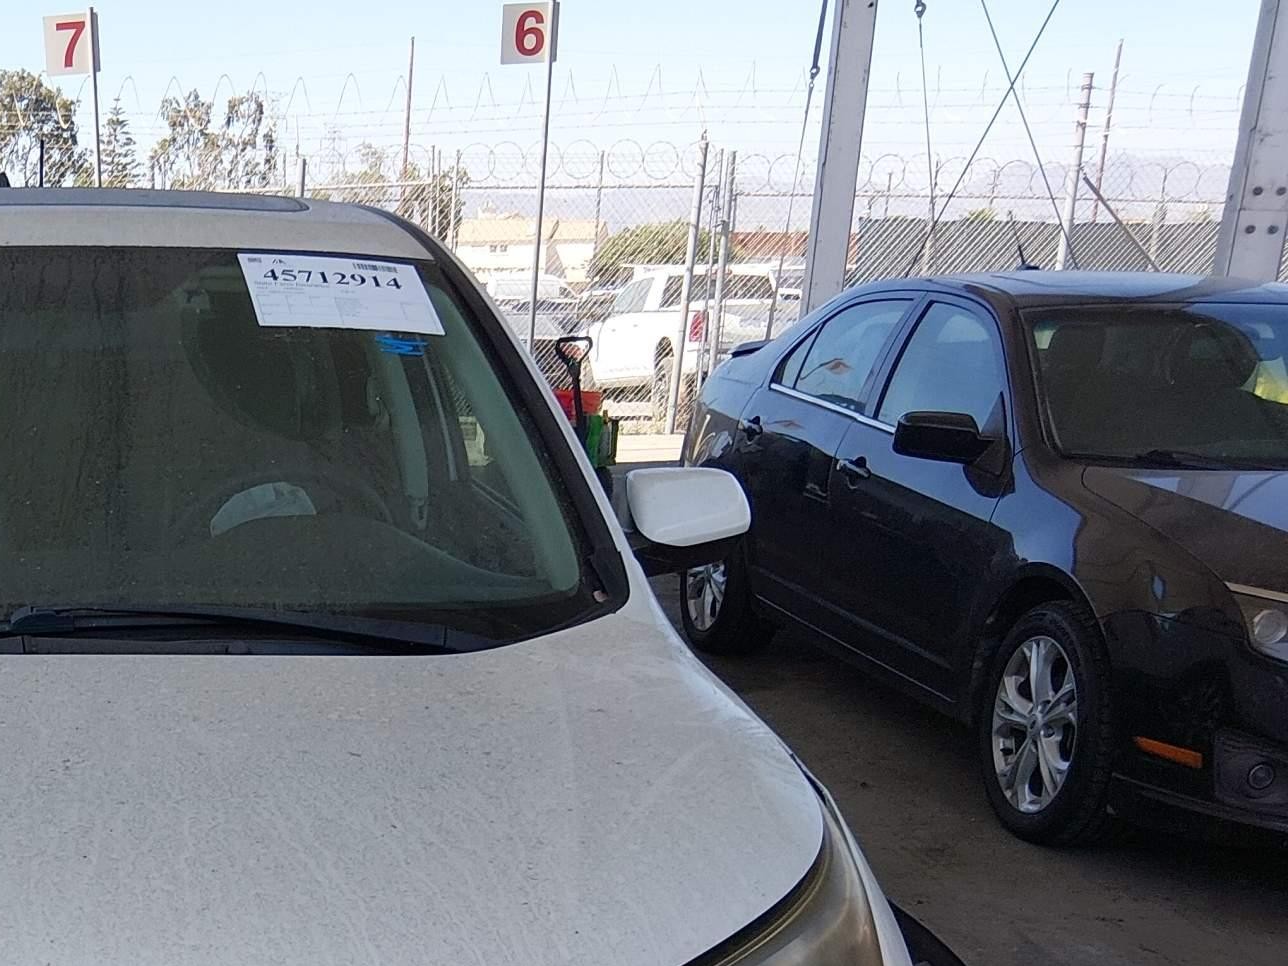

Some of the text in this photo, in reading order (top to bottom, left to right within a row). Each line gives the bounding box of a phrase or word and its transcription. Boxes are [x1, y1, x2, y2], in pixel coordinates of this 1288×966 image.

[55, 21, 86, 68] 7
[515, 10, 545, 56] 6
[263, 268, 402, 290] 45712914
